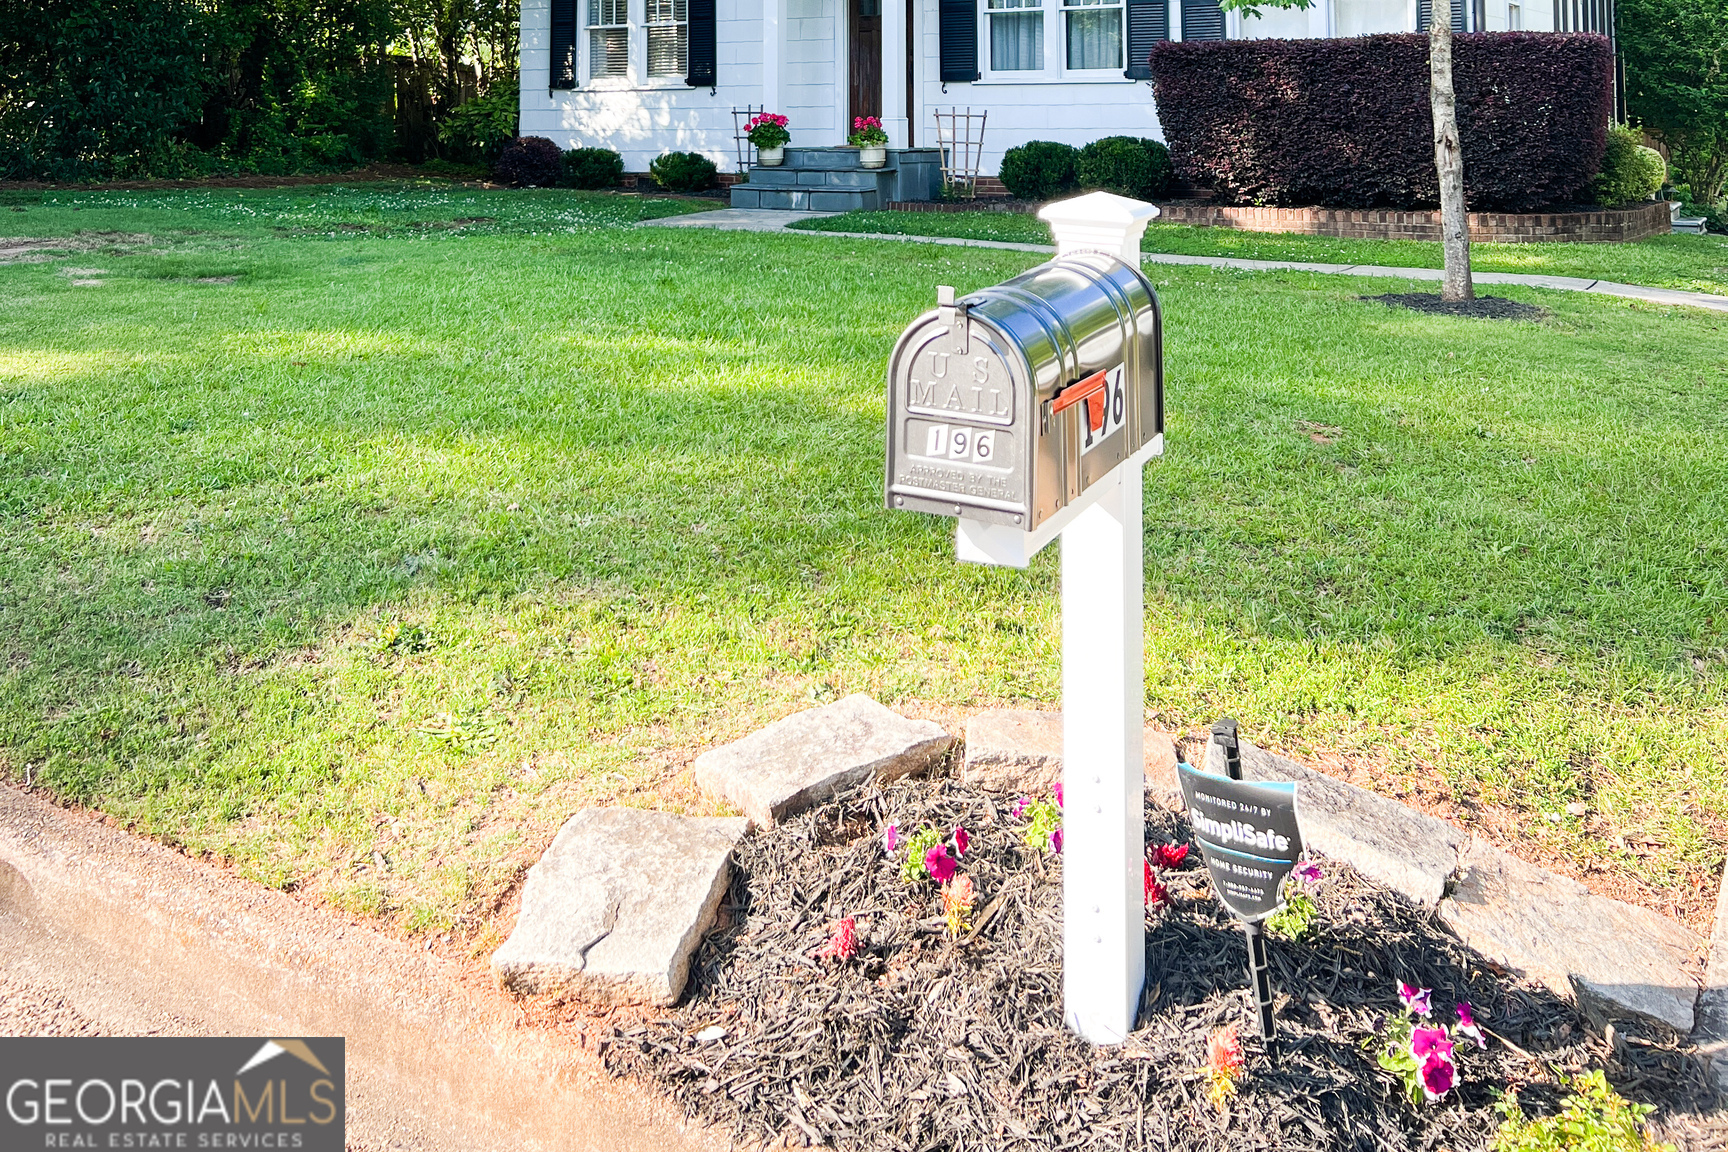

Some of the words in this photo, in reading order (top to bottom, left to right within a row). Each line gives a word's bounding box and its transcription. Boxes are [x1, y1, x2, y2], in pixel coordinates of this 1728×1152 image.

[927, 351, 951, 378] U
[972, 356, 990, 384] S
[909, 378, 1010, 418] MAIL
[934, 429, 991, 458] 196
[899, 473, 966, 494] POSTMASTER
[970, 484, 1019, 501] GENERAL
[910, 464, 965, 481] APPROVED
[969, 472, 983, 484] BY
[987, 475, 1008, 488] THE
[1195, 790, 1237, 810] MONITORED
[1239, 801, 1259, 815] 24/7
[1261, 807, 1272, 817] BY
[1190, 807, 1290, 852] SimpliSafe
[1210, 856, 1231, 872] HOME
[1232, 863, 1273, 880] SECURITY
